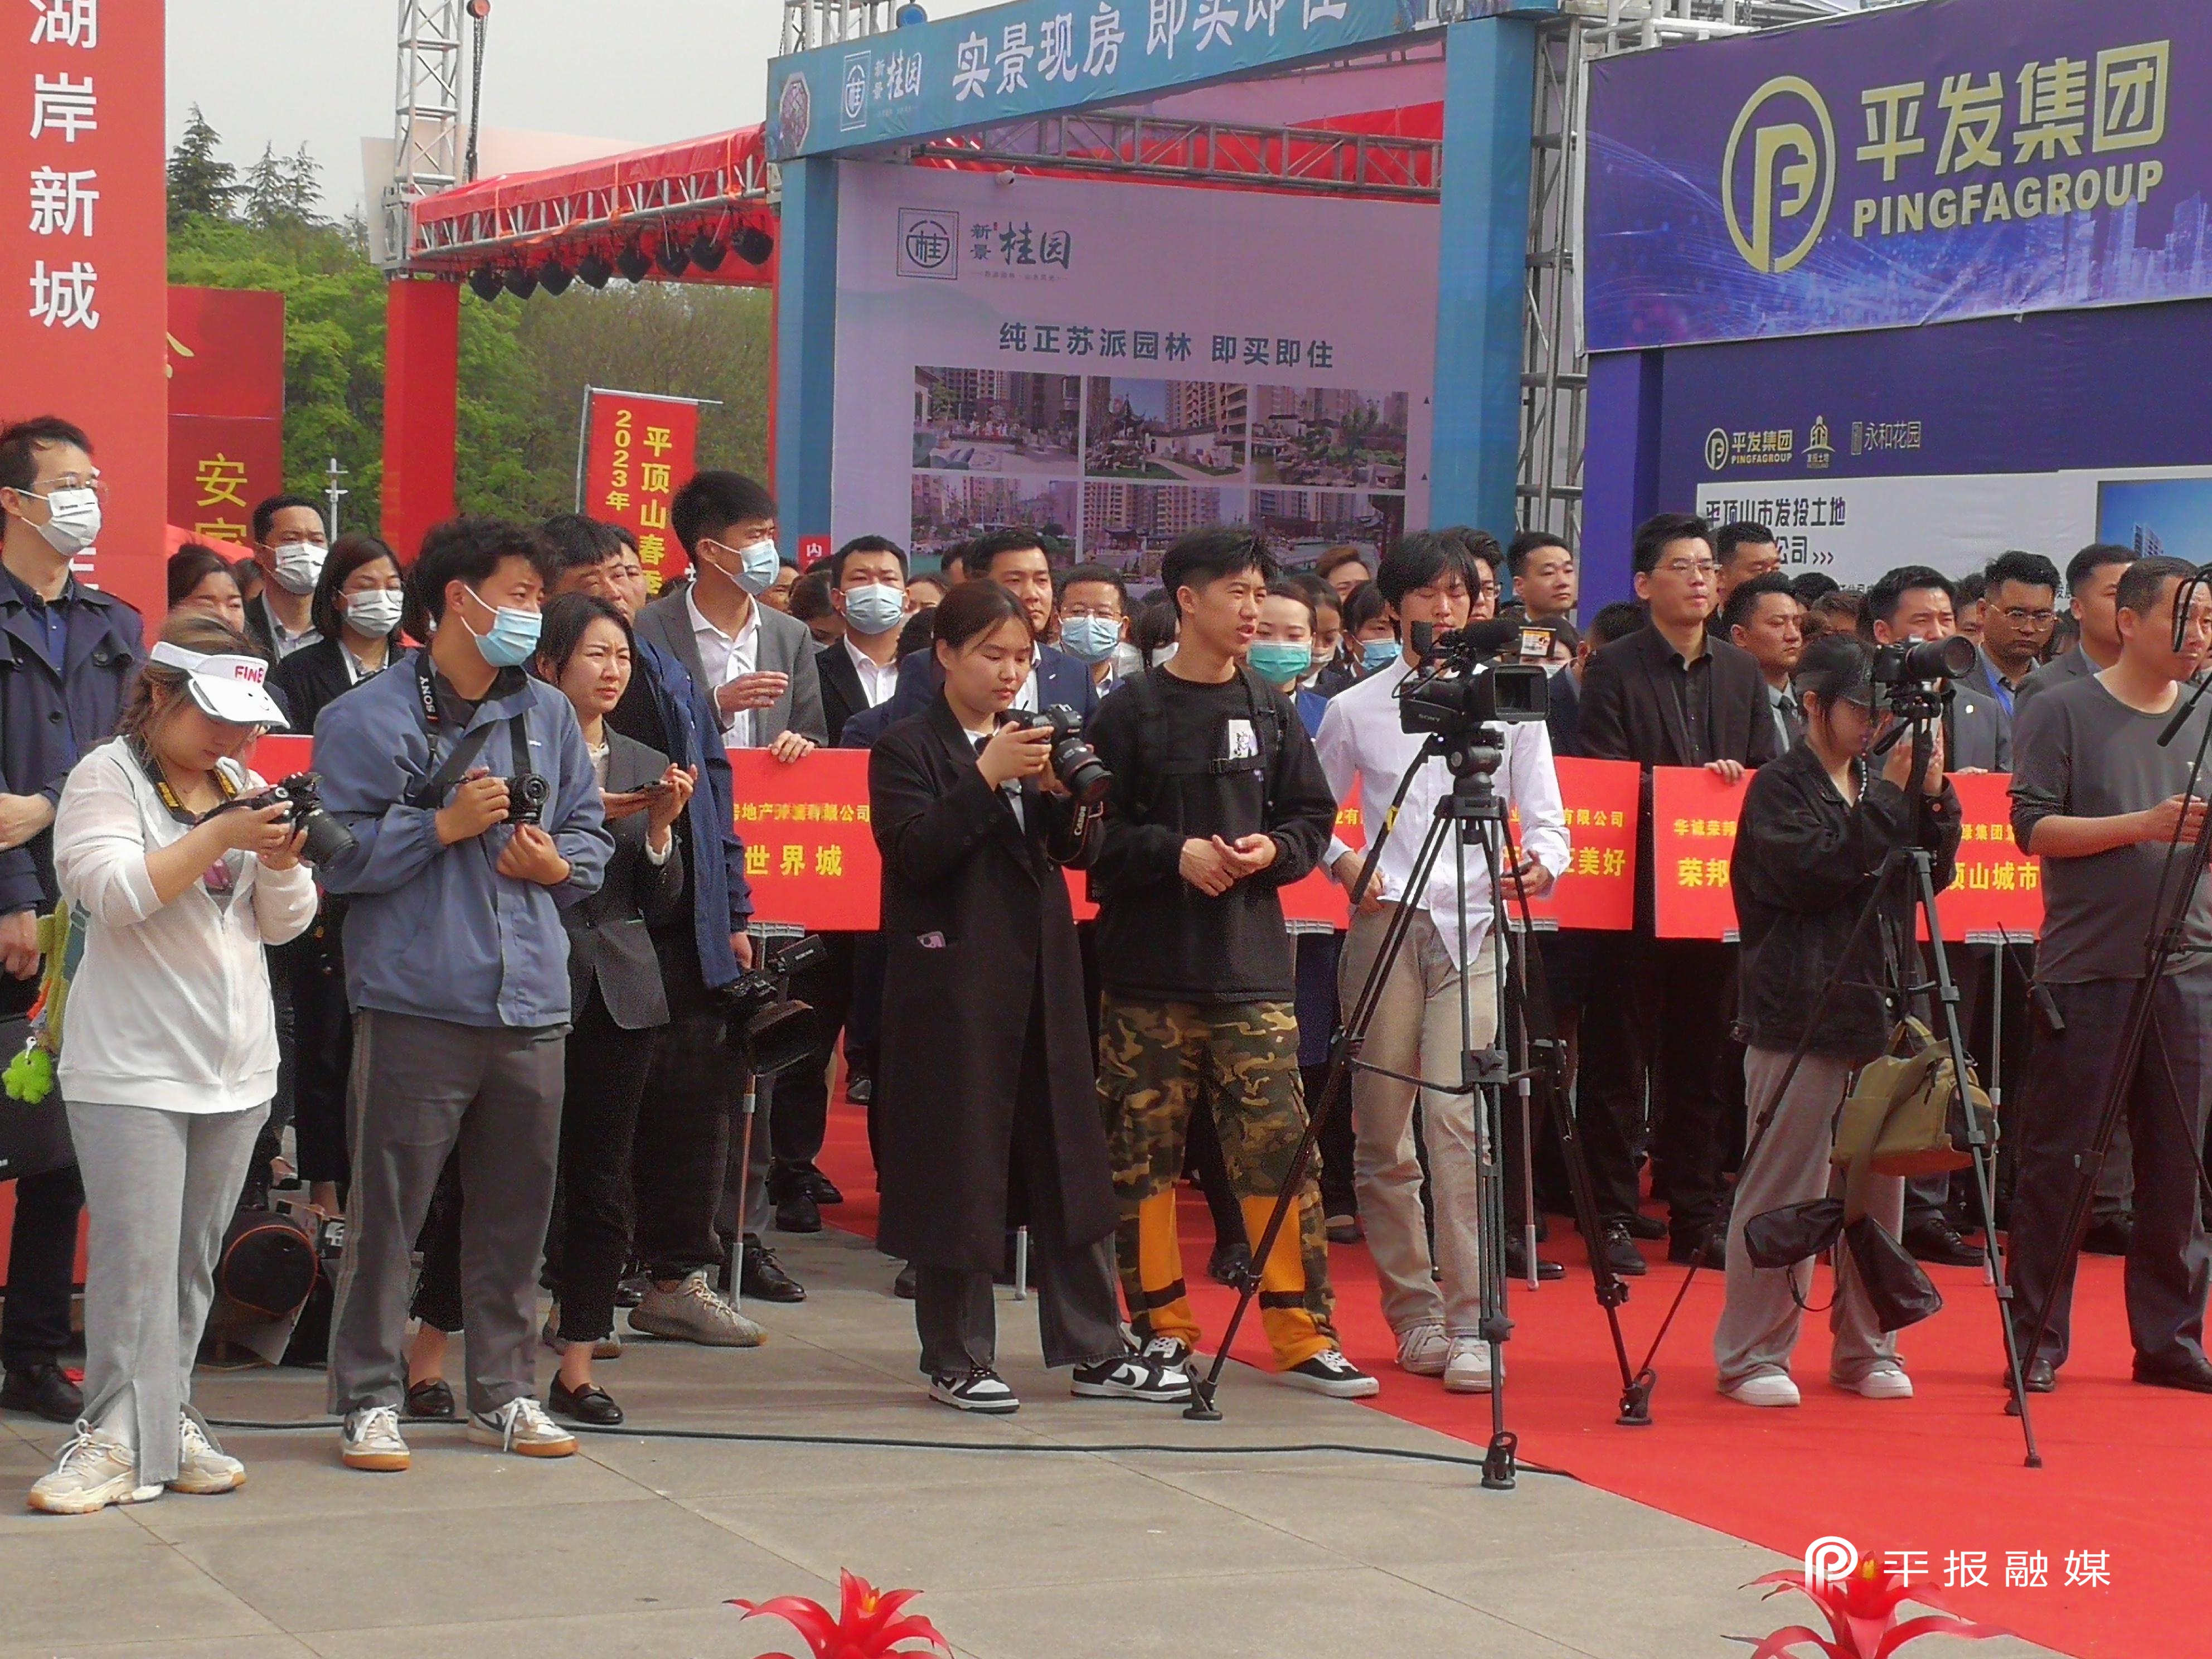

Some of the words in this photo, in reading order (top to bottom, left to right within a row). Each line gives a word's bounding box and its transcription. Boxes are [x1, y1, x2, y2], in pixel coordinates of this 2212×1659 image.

[952, 2, 1125, 101] 实景现房
[1856, 40, 2170, 182] 平发集团
[28, 0, 100, 329] 湖岸新城
[1853, 160, 2164, 238] PINGFAGROUP
[999, 221, 1071, 269] 桂园
[999, 322, 1192, 362] 纯正苏派园林
[1211, 335, 1333, 368] 即买即住
[1731, 453, 1792, 464] PINGFAGROUP
[1732, 429, 1793, 451] 平发集团
[1865, 421, 1921, 450] 永和花园
[605, 410, 632, 511] 2023年
[420, 676, 436, 713] SONY
[745, 844, 843, 876] 世界城
[1677, 857, 1730, 887] 荣邦
